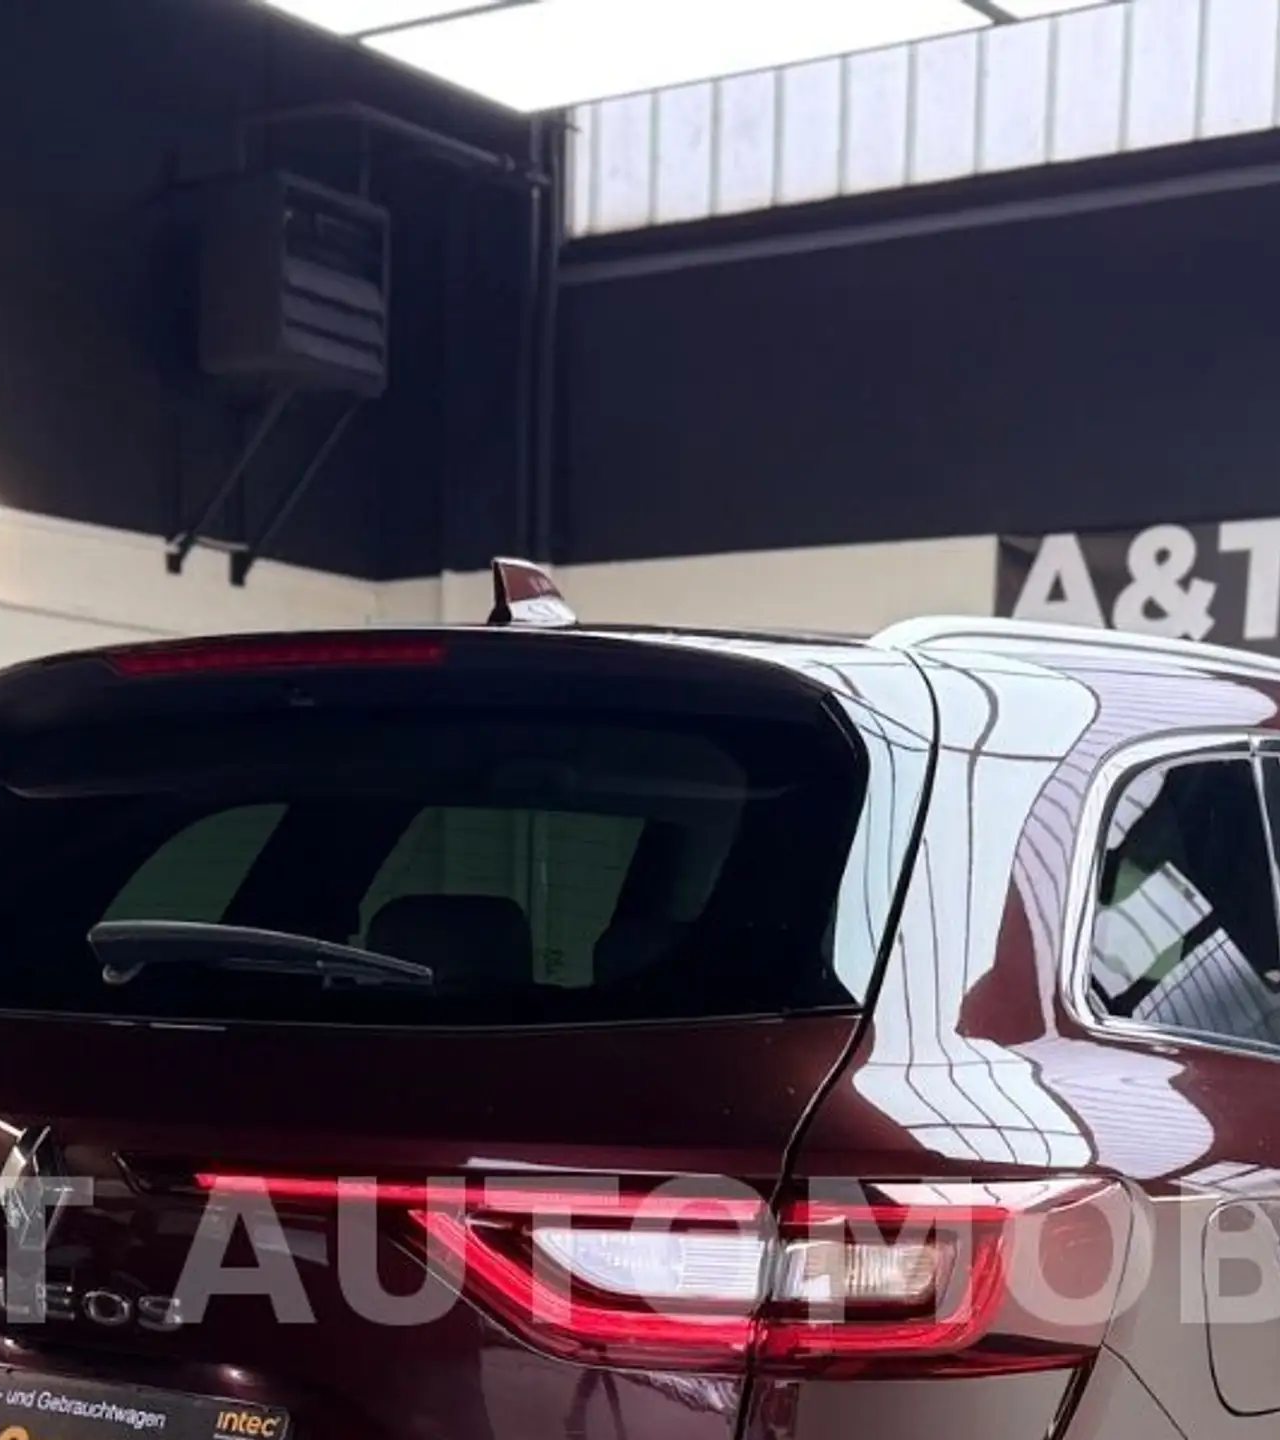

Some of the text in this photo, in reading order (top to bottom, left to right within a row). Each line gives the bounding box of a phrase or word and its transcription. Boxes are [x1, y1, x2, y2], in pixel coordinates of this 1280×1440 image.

[5, 1387, 36, 1409] und
[36, 1390, 167, 1430] Gebrauchtwagen
[216, 1410, 281, 1438] intec
